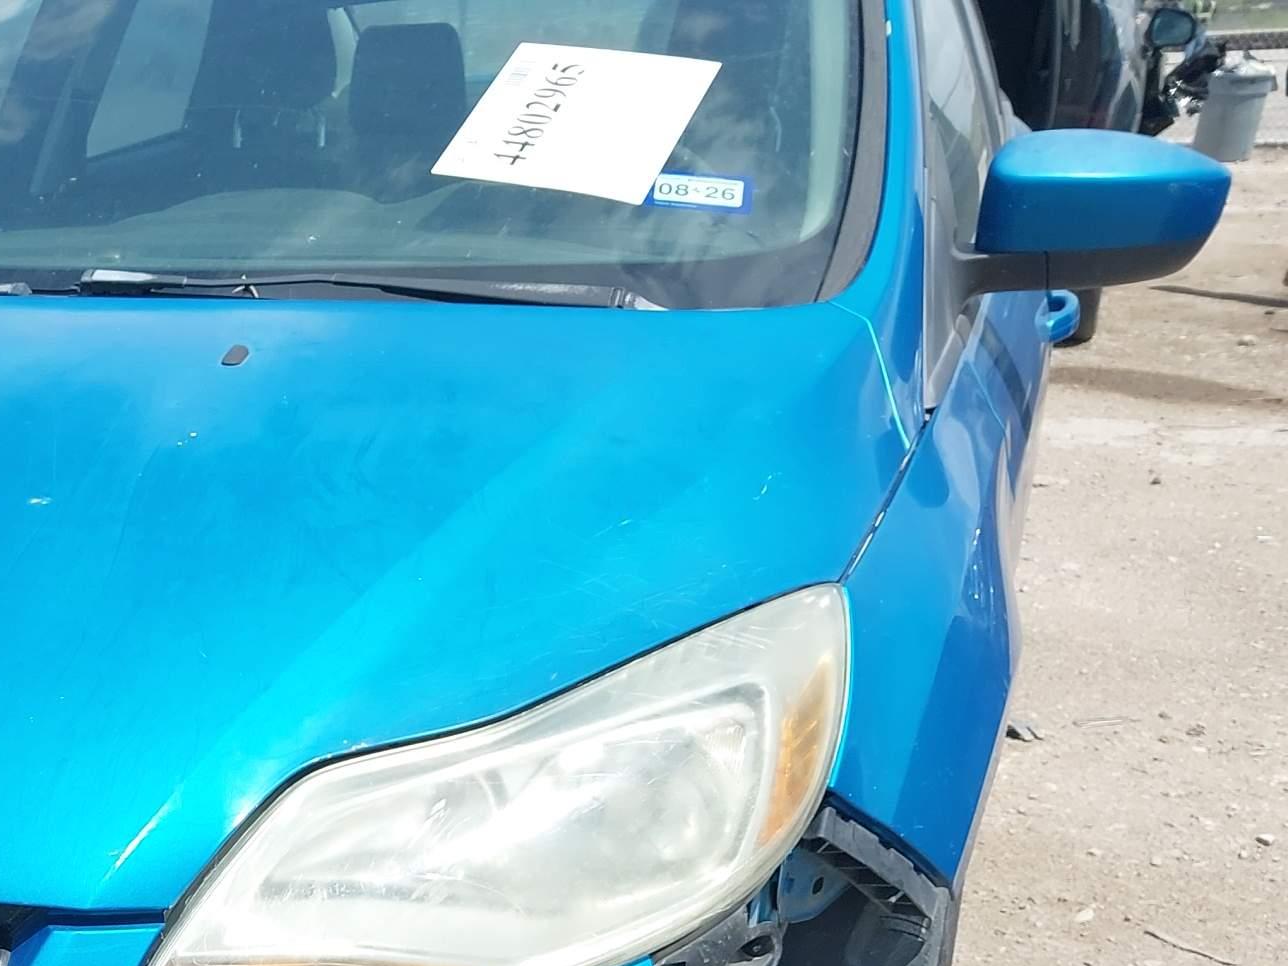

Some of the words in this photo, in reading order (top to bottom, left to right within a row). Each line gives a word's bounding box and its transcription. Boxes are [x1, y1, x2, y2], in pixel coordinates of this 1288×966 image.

[493, 63, 585, 166] 44802965
[658, 182, 689, 197] 08
[704, 185, 736, 201] 26
